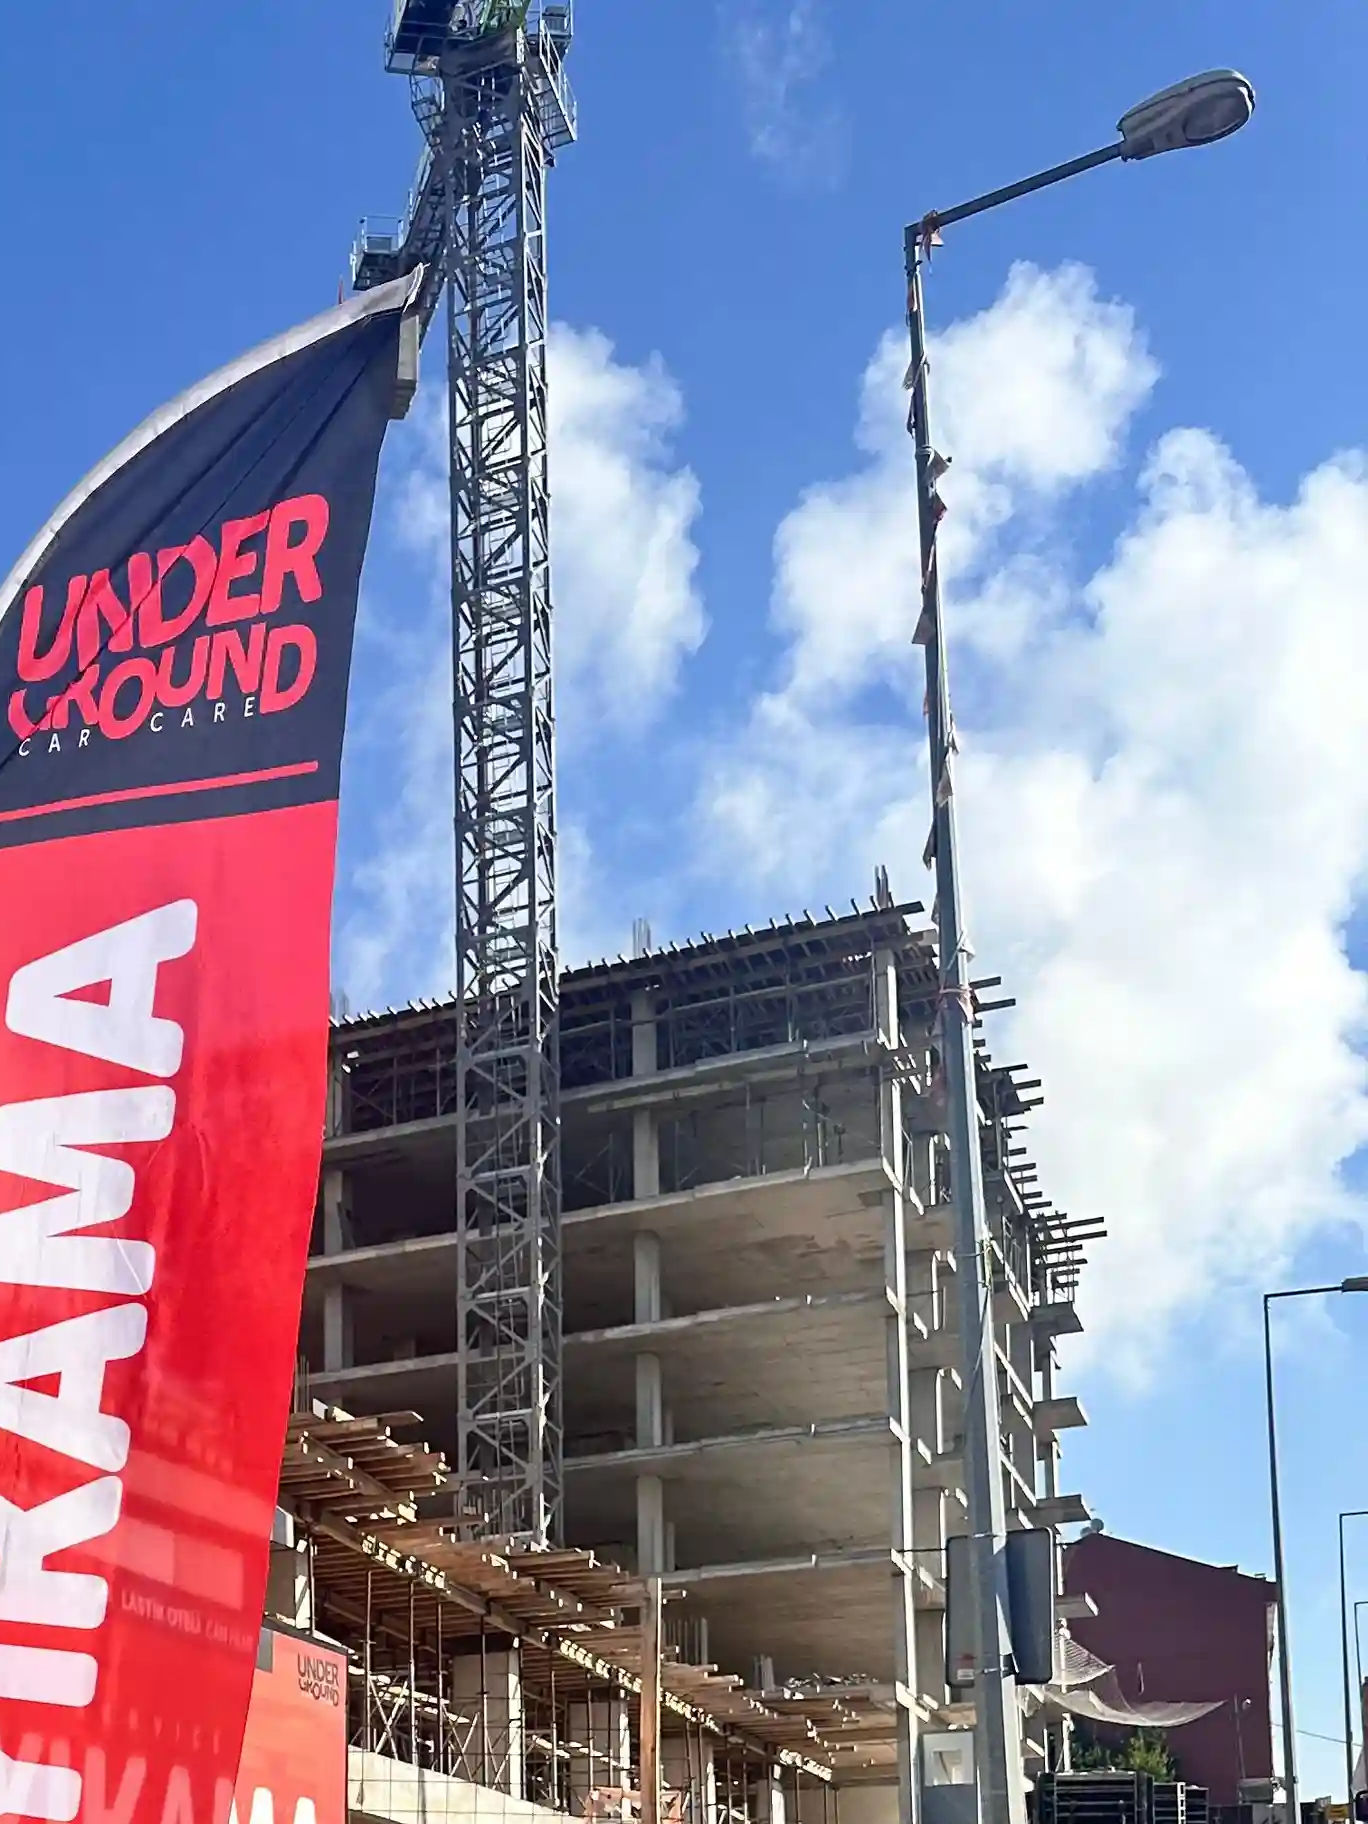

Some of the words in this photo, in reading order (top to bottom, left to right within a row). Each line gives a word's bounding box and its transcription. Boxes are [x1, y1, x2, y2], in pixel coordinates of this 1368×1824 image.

[17, 493, 329, 682] UNDER
[8, 623, 317, 740] GROUND
[18, 729, 91, 756] CAR
[150, 696, 256, 733] CARE
[297, 1651, 340, 1687] UNDER
